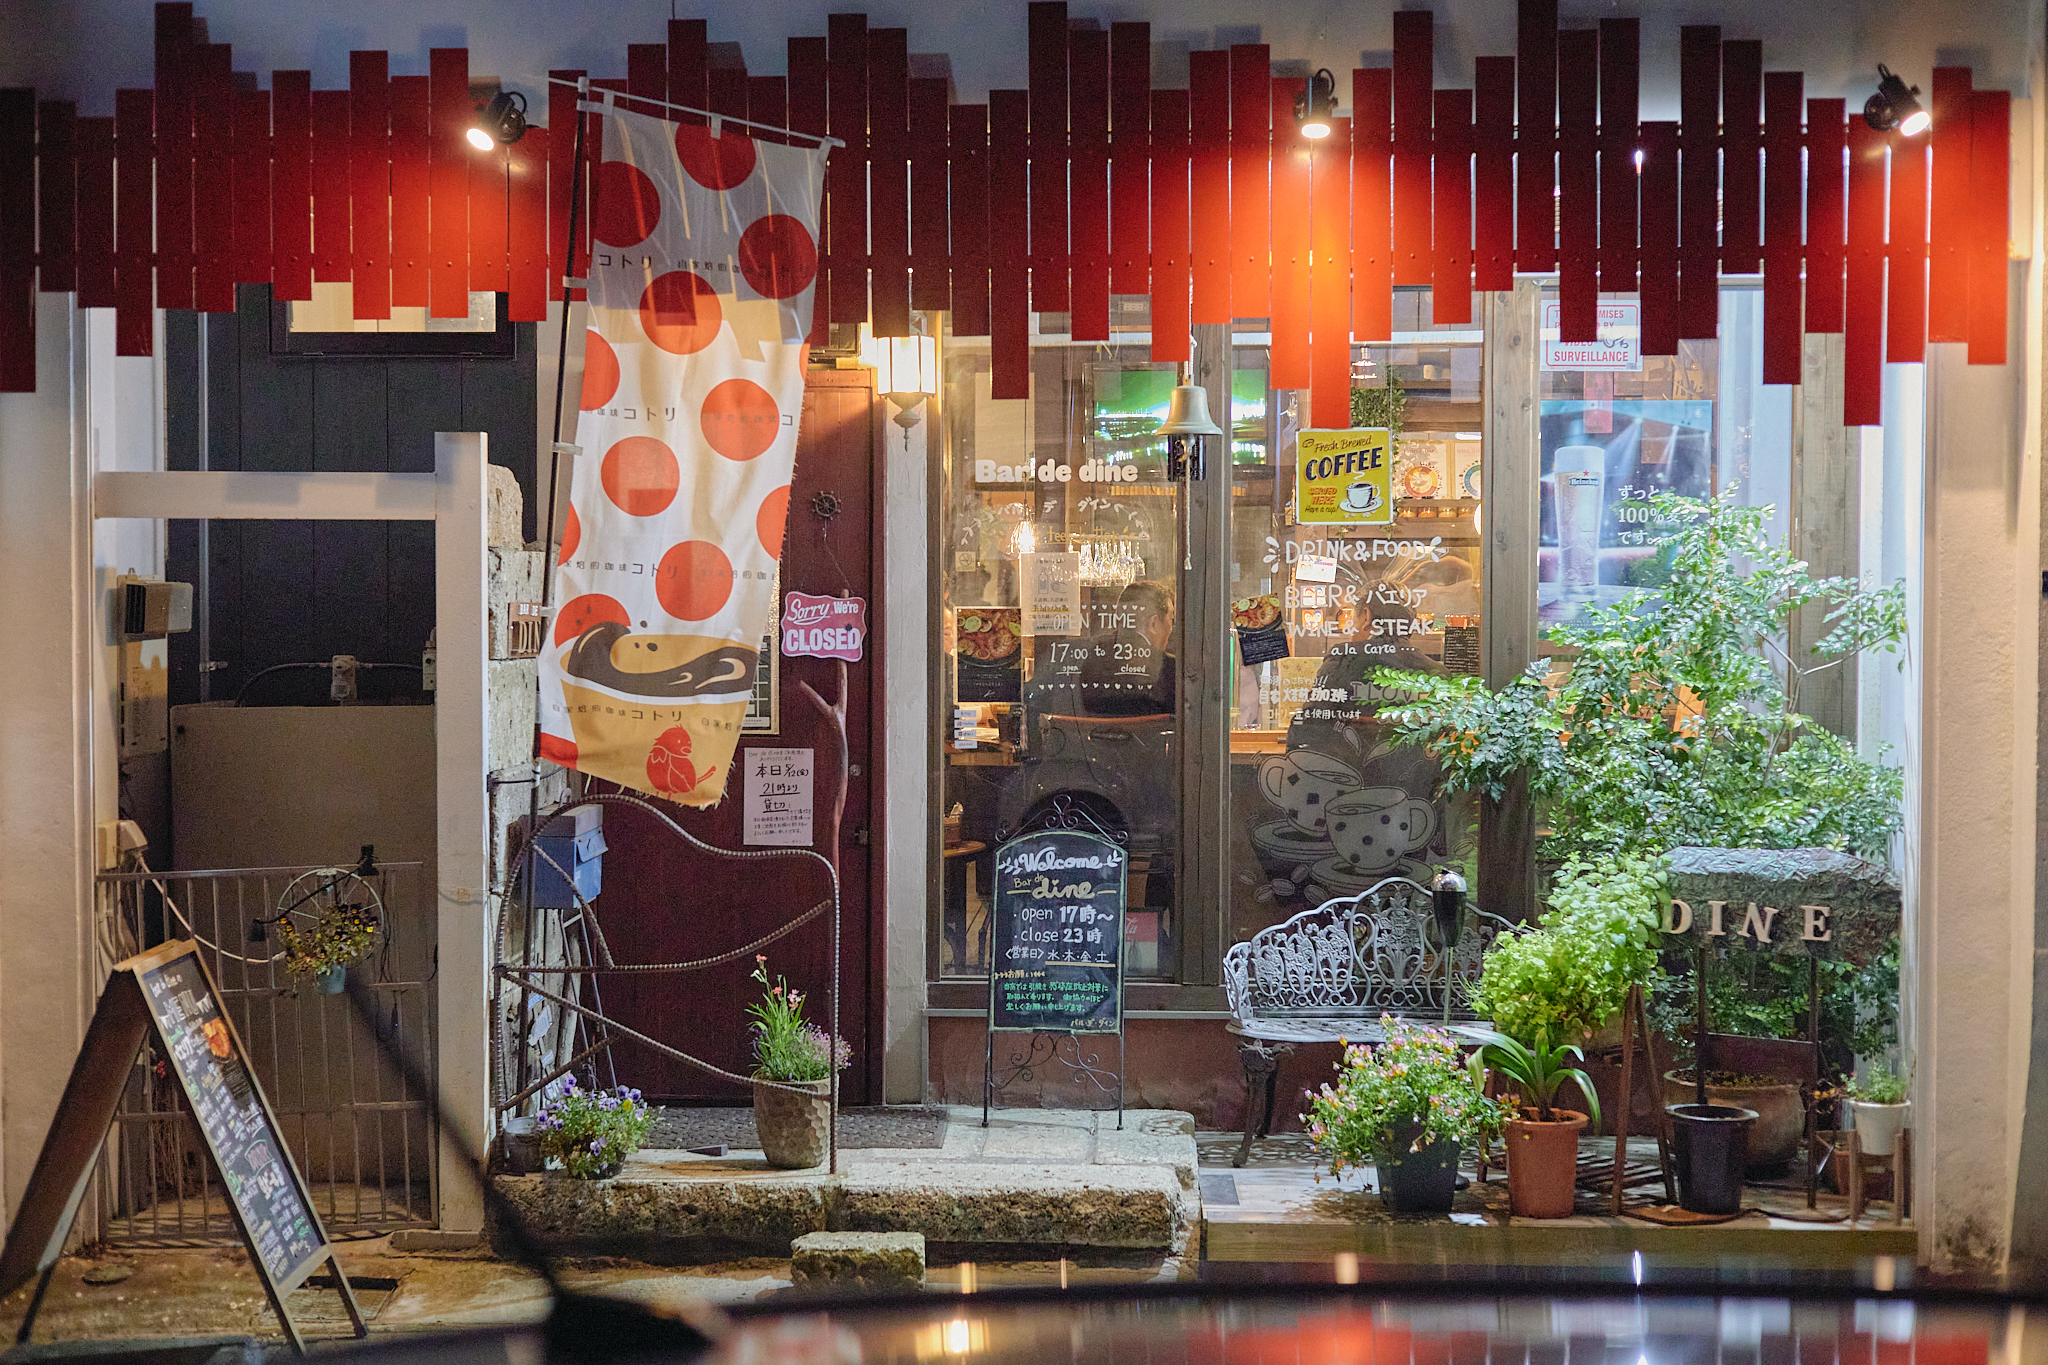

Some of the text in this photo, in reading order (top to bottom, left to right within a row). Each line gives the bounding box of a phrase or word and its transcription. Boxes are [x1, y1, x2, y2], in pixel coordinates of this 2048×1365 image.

[1599, 309, 1624, 319] MISES
[1554, 351, 1629, 362] SURVEILLANCE
[1314, 434, 1372, 453] Fresh Brewed
[975, 458, 1138, 483] Bar de dine
[1304, 446, 1383, 483] COFFEE
[1617, 485, 1661, 501] ずっと
[1077, 497, 1111, 513] ダイン
[1366, 583, 1428, 608] パエリア
[787, 598, 859, 625] Sorry We're
[1053, 612, 1090, 631] OPEN
[1097, 612, 1137, 629] TIME
[1370, 617, 1436, 637] STEAK
[518, 620, 540, 656] DIN
[786, 627, 861, 652] CLOSED
[1050, 641, 1151, 663] 17:00 to 23:00
[1363, 643, 1397, 655] Carte
[1120, 663, 1146, 673] closed
[755, 762, 781, 779] 本日
[761, 782, 799, 796] 21時より
[1018, 846, 1104, 873] Welcome
[1013, 873, 1097, 900] Bar de dine
[1021, 908, 1054, 924] open
[1659, 898, 1833, 944] DINE
[1020, 926, 1060, 943] close
